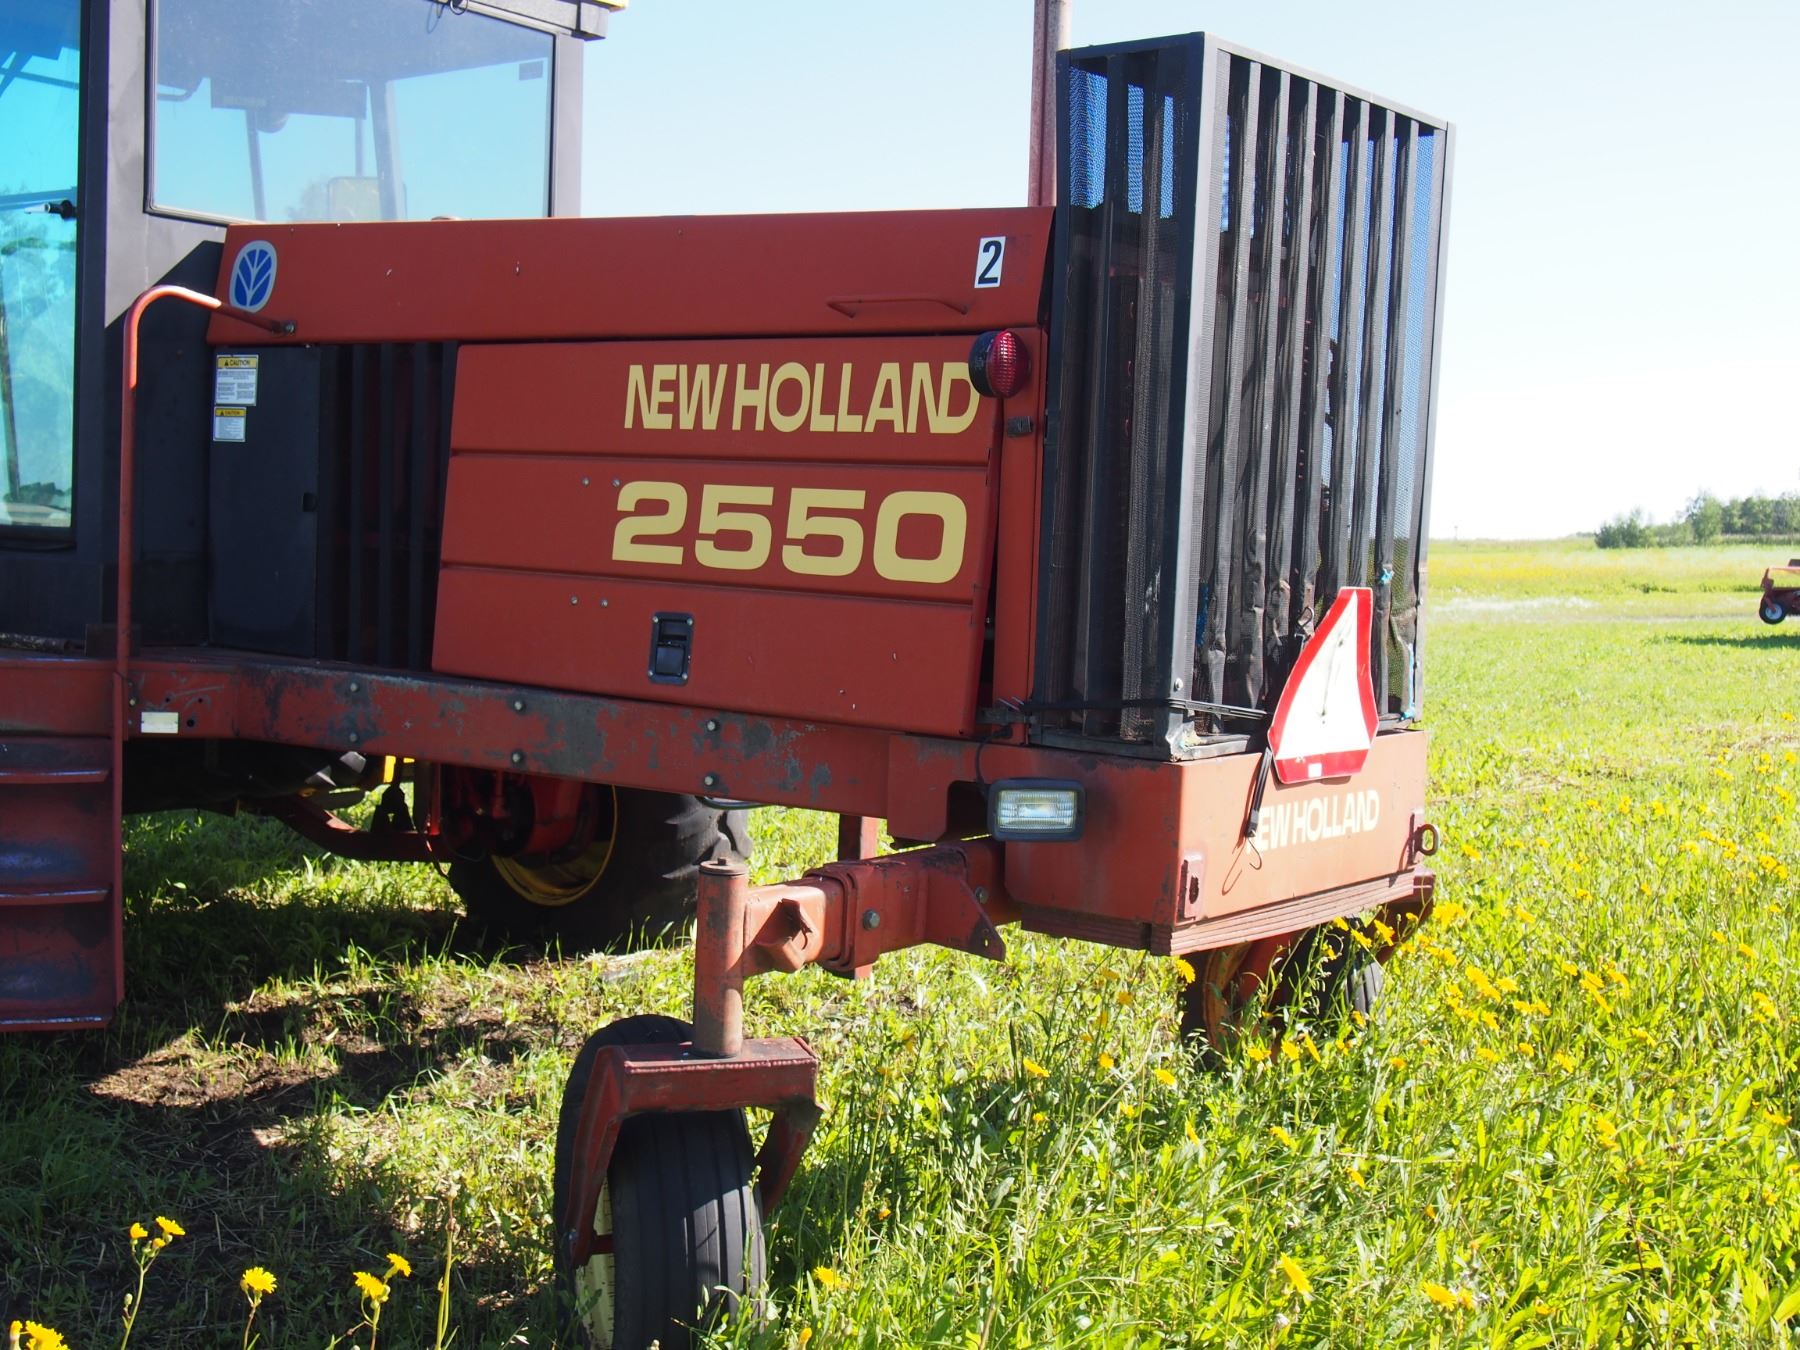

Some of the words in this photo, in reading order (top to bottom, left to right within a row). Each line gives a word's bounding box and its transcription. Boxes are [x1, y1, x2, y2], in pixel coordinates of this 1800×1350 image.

[978, 240, 1002, 284] 2
[624, 363, 728, 431] NEW
[732, 362, 980, 434] HOLLAND
[612, 481, 967, 583] 2550
[1292, 789, 1380, 845] HOLLAND
